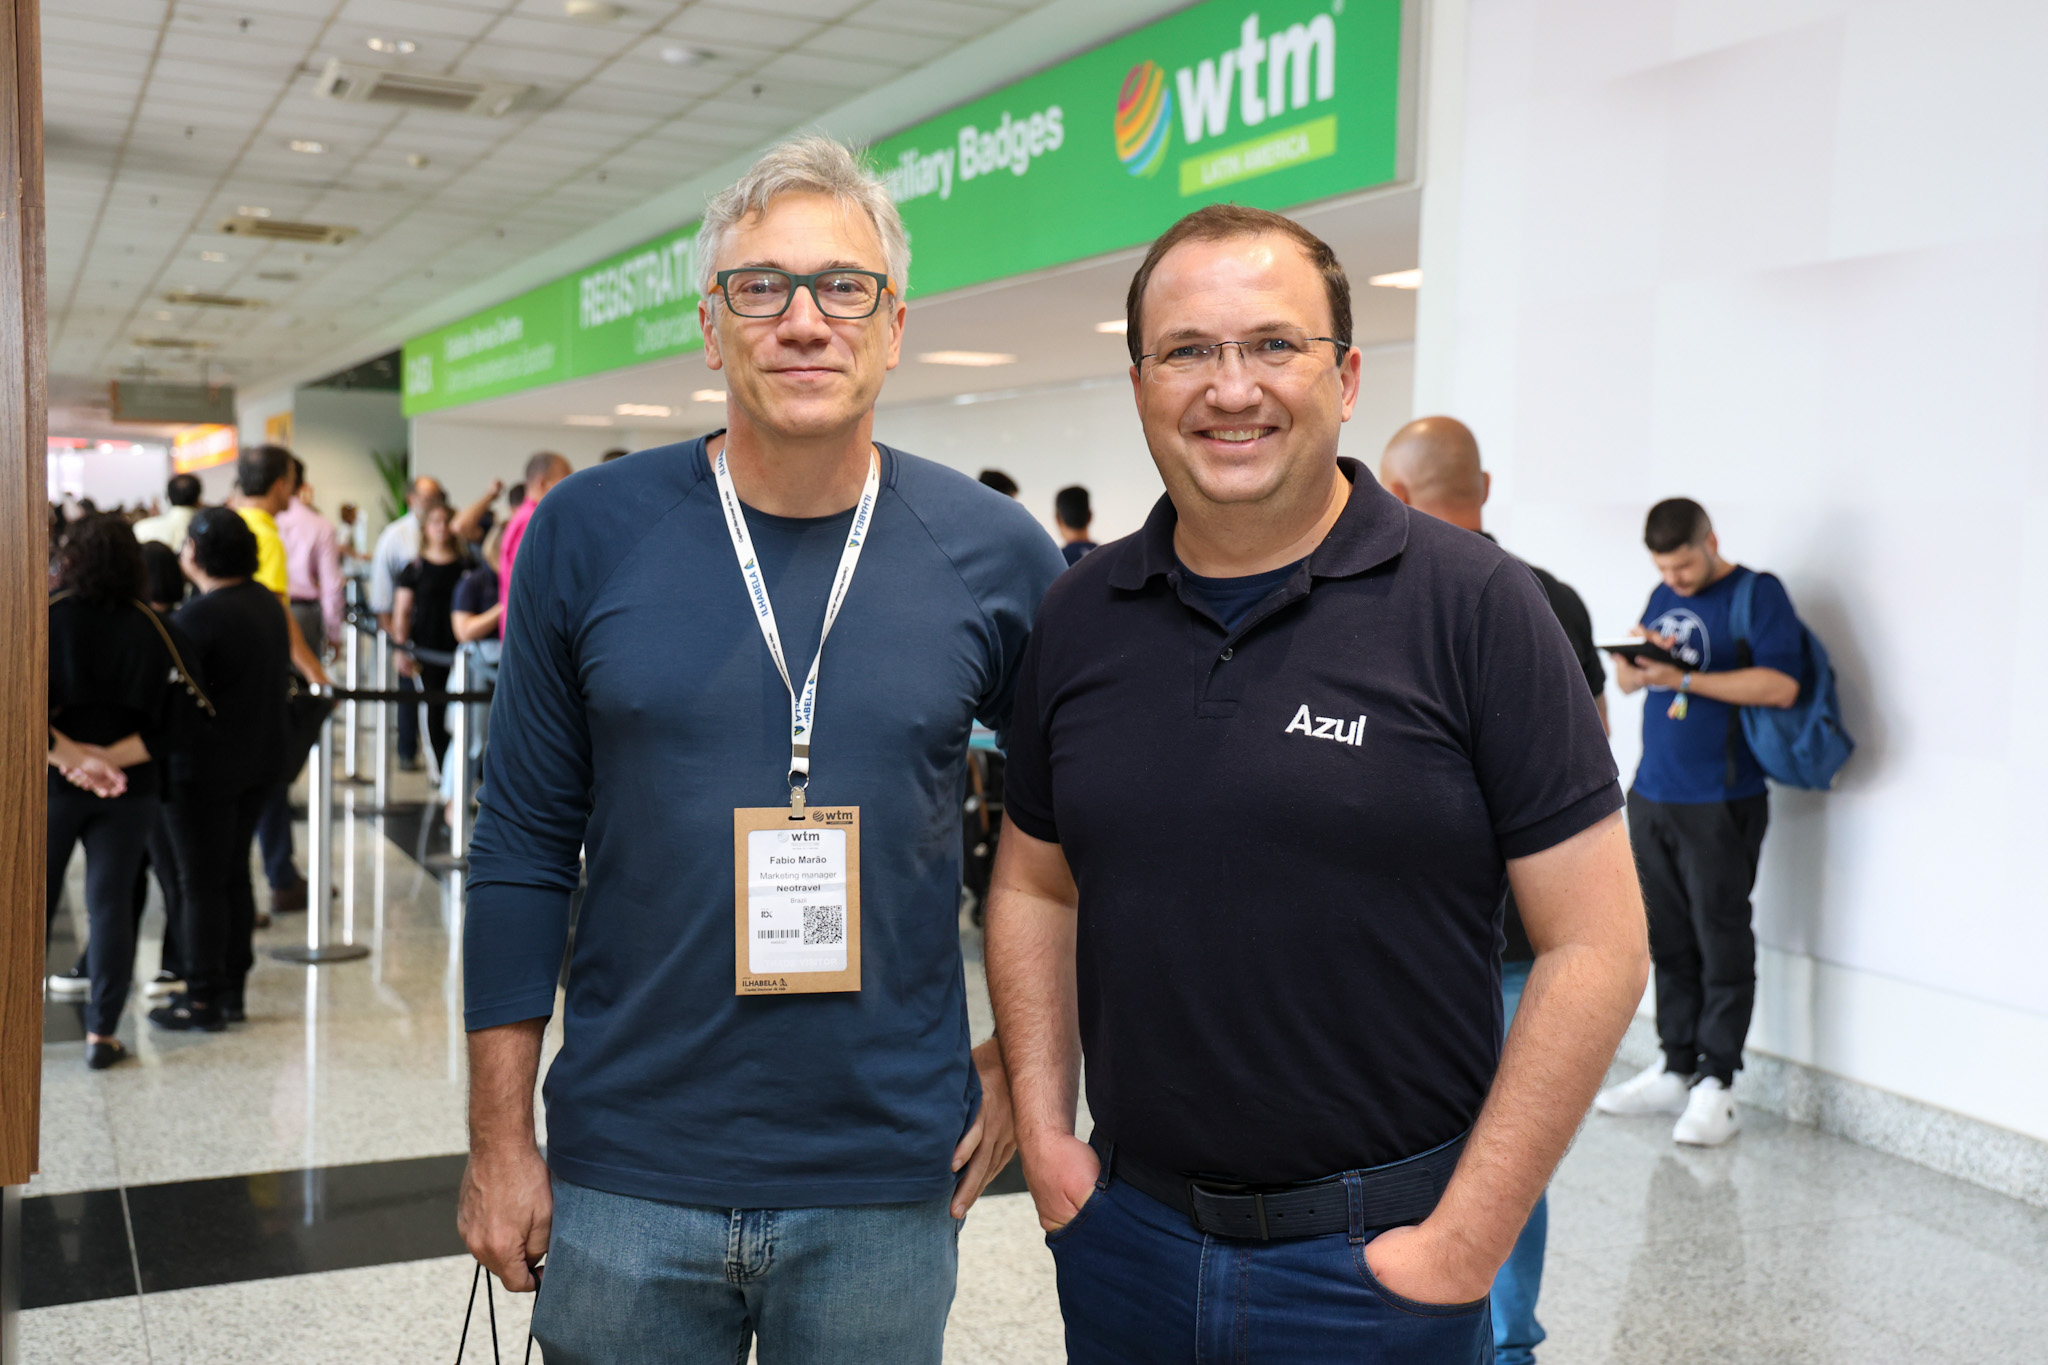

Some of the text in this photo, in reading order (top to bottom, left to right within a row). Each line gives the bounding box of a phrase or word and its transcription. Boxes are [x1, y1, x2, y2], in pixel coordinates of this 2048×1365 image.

[1176, 13, 1336, 143] wtm
[957, 105, 1065, 181] Badges
[853, 494, 872, 536] ILHABELA
[749, 571, 769, 617] ILHABELA
[1285, 704, 1367, 746] Azul
[825, 810, 853, 820] wtm
[791, 831, 820, 841] wtm
[769, 855, 827, 865] Fabio Marão
[760, 872, 837, 881] Marketing manager
[776, 884, 821, 892] Neotravel
